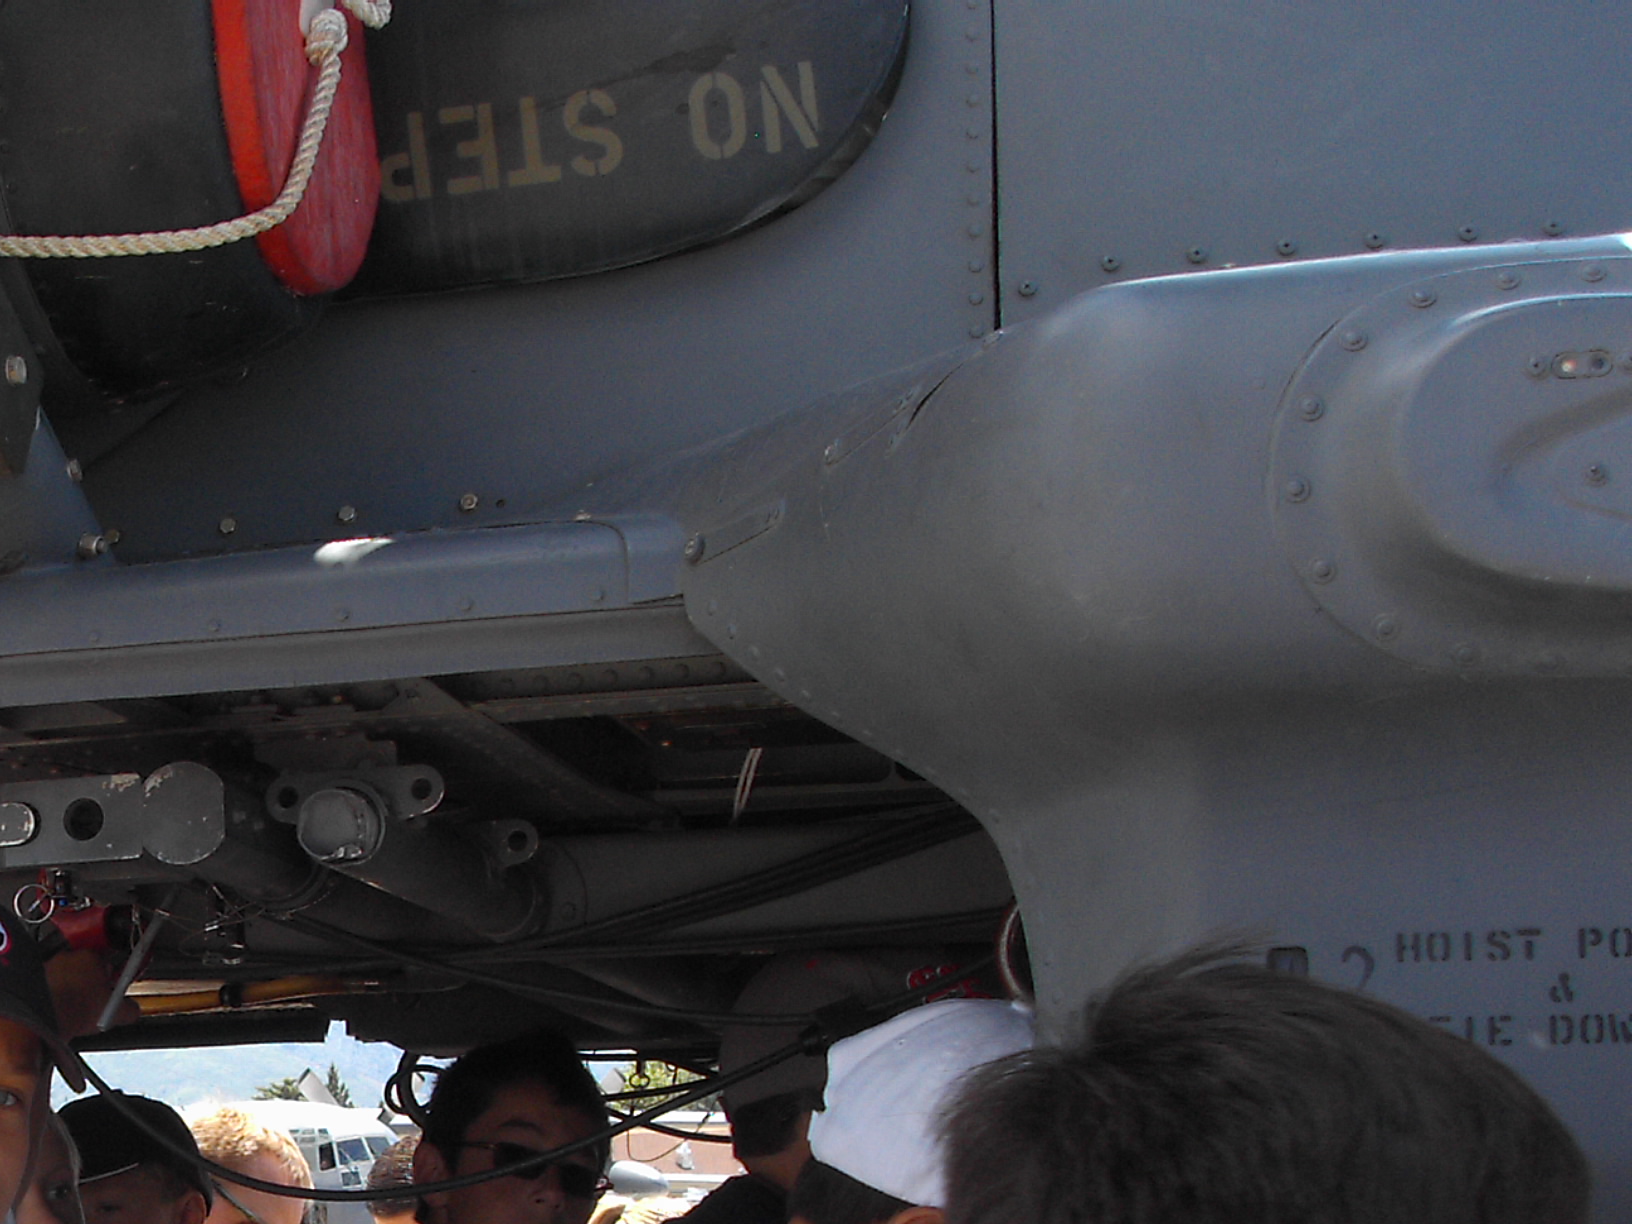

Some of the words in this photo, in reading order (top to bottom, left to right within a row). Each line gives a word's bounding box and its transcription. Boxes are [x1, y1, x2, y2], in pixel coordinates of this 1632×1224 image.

[381, 89, 624, 201] STEP
[688, 61, 820, 161] NO
[1396, 928, 1542, 963] HOIST
[1578, 927, 1632, 959] PO
[1549, 972, 1574, 1003] &
